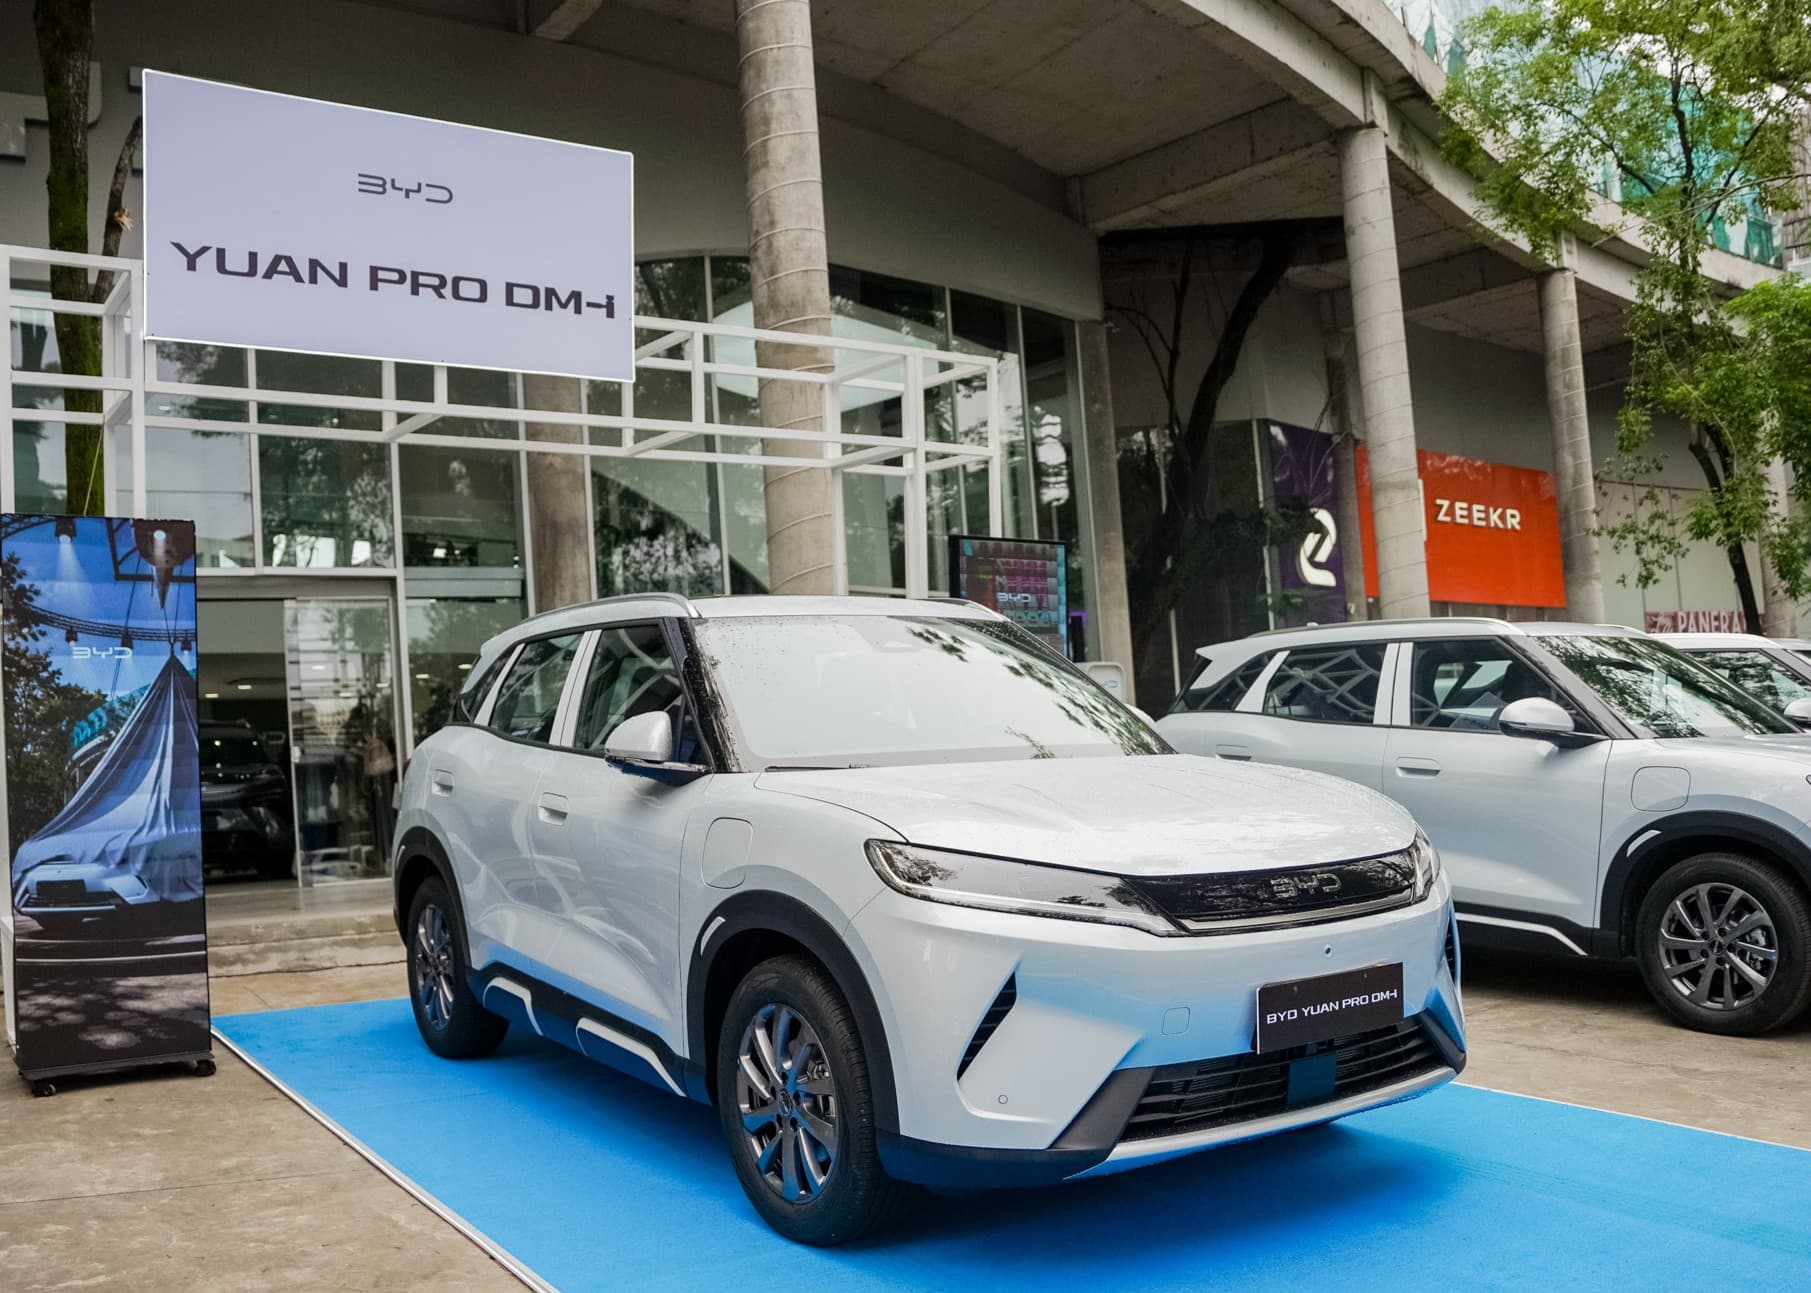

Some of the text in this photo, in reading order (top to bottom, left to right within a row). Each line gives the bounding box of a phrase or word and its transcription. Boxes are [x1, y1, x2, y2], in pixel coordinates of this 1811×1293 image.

[358, 173, 454, 205] BYD
[170, 241, 616, 319] YUAN PRO DM-i
[1435, 498, 1521, 531] ZEEKR
[996, 592, 1032, 602] BYD
[72, 646, 133, 659] BYD
[1271, 874, 1342, 898] BYD
[1267, 1009, 1298, 1025] BYD
[1302, 1001, 1339, 1017] YUAN
[1342, 995, 1369, 1009] PRO
